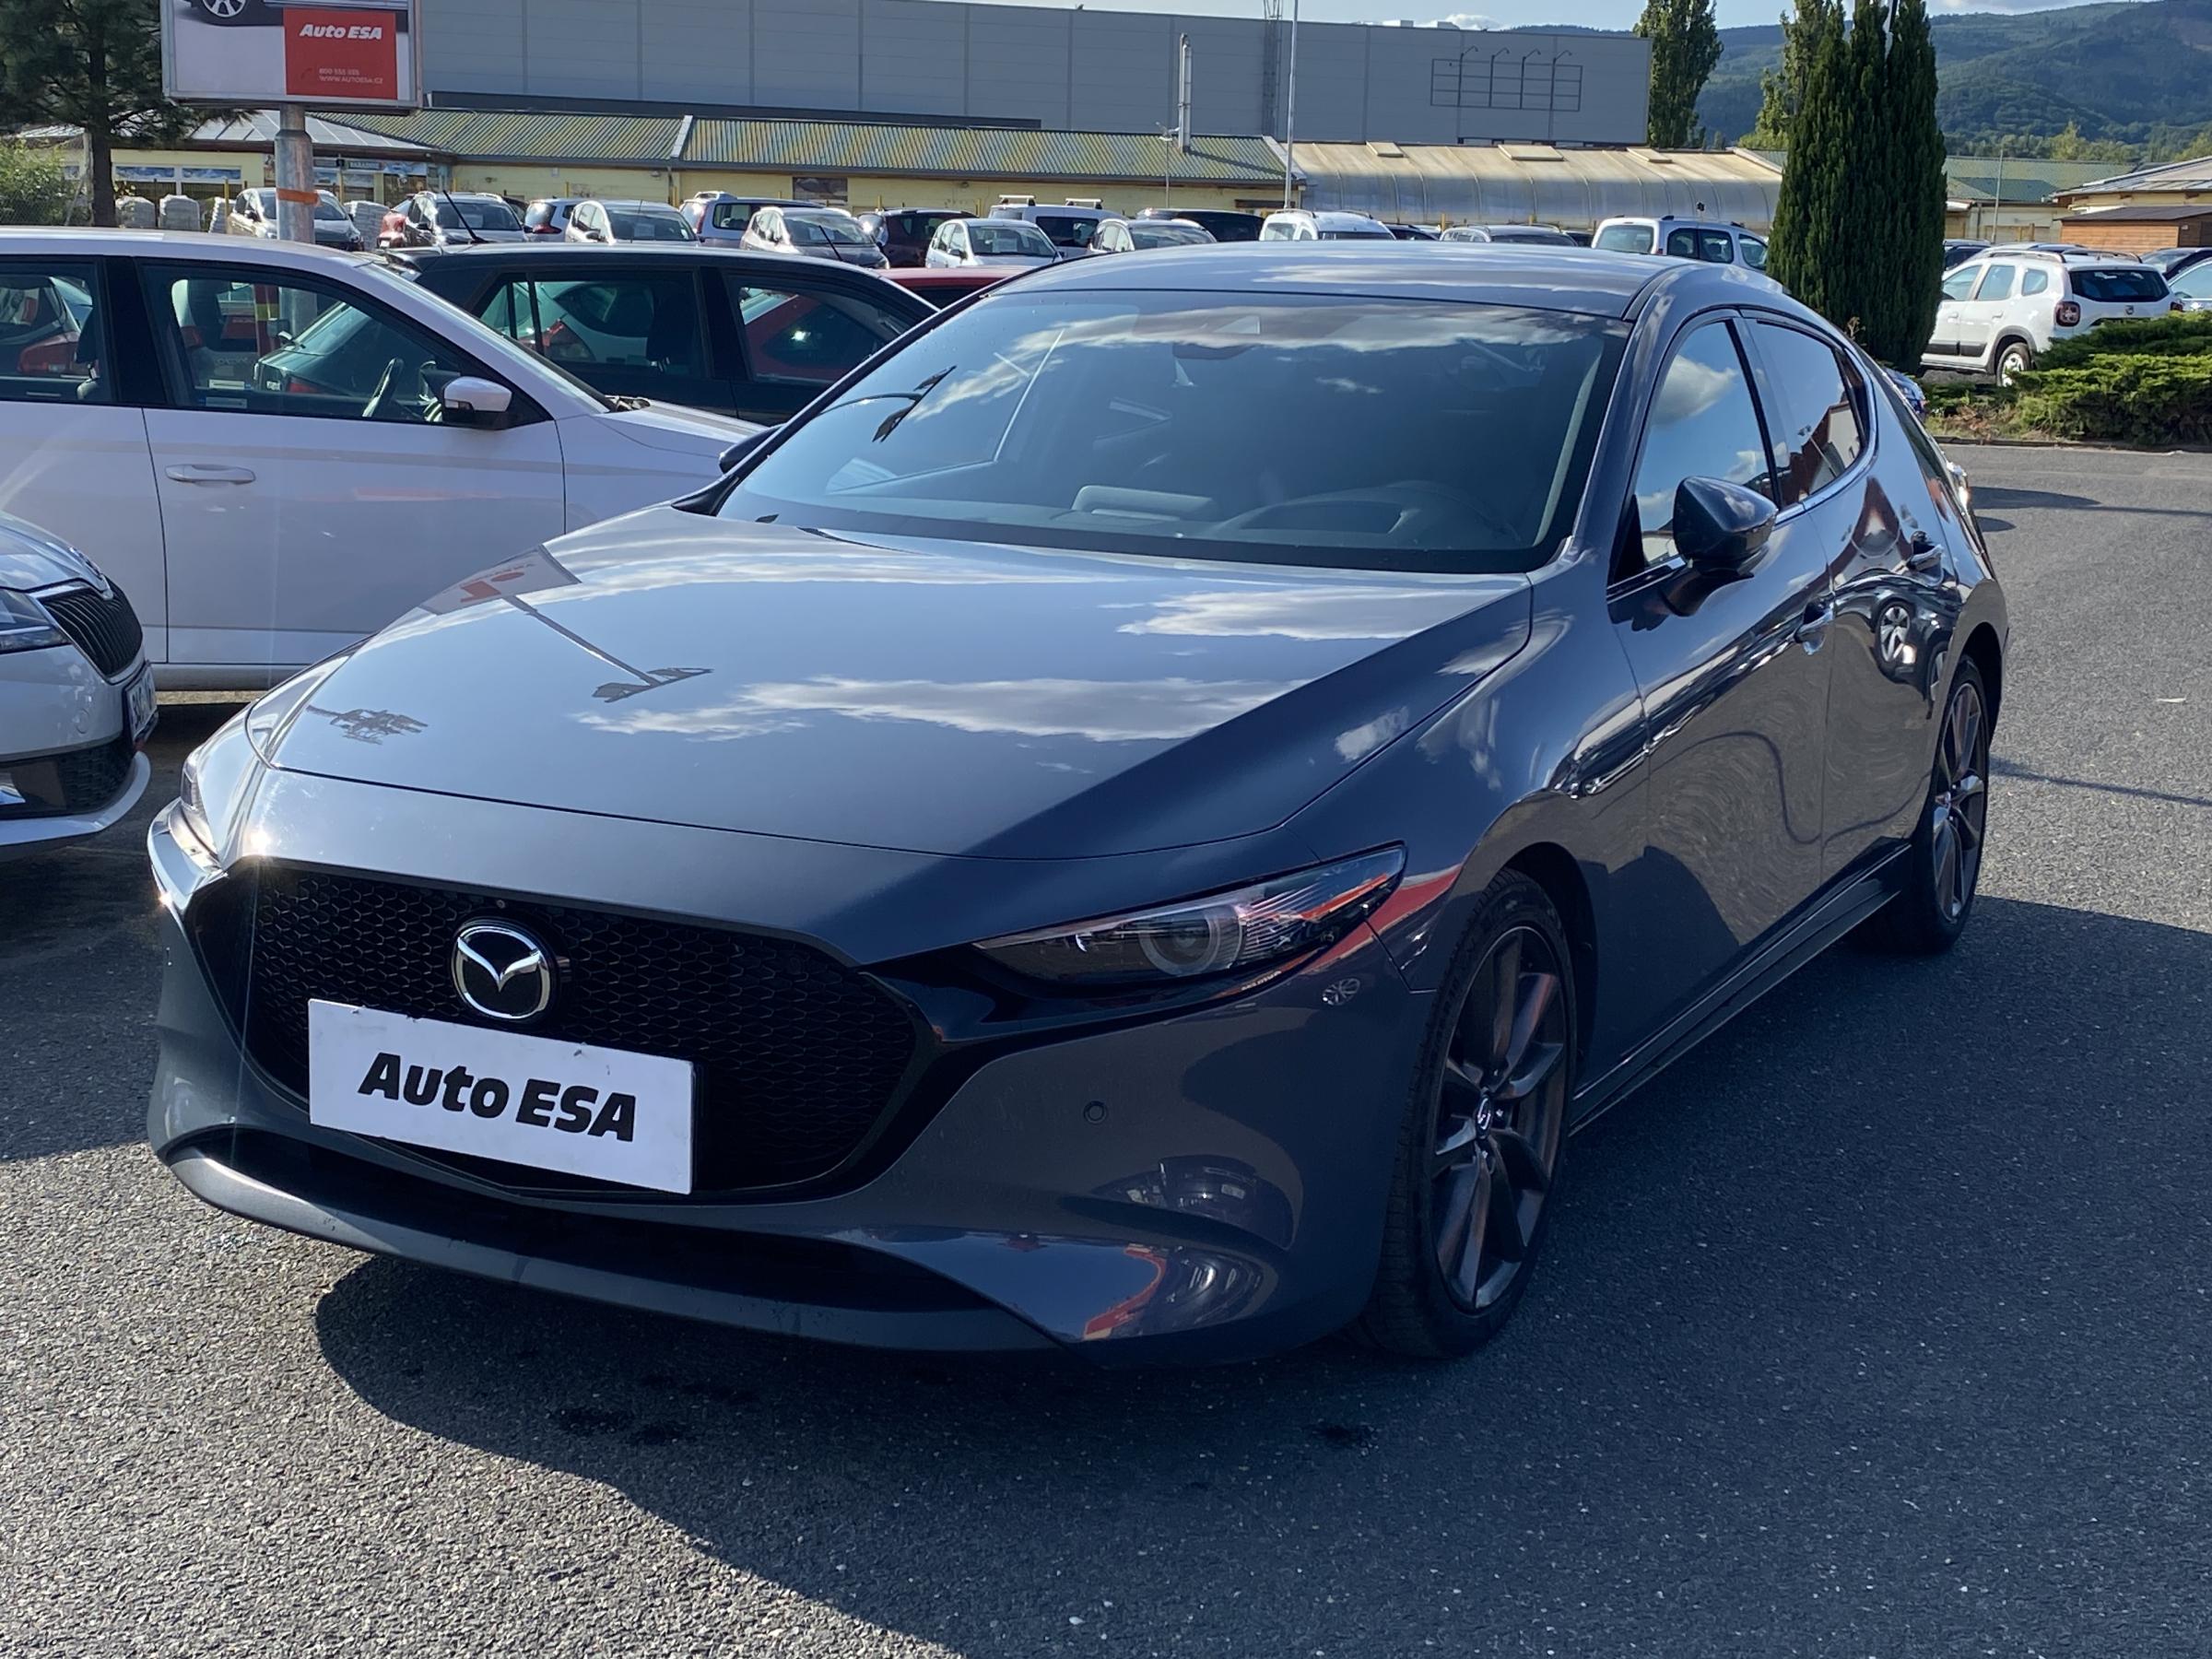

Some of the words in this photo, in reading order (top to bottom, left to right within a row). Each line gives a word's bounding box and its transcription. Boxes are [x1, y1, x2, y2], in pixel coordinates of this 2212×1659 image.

[300, 24, 346, 38] Auto
[347, 26, 382, 40] ESA
[358, 1052, 510, 1119] Auto
[515, 1078, 636, 1142] ESA
